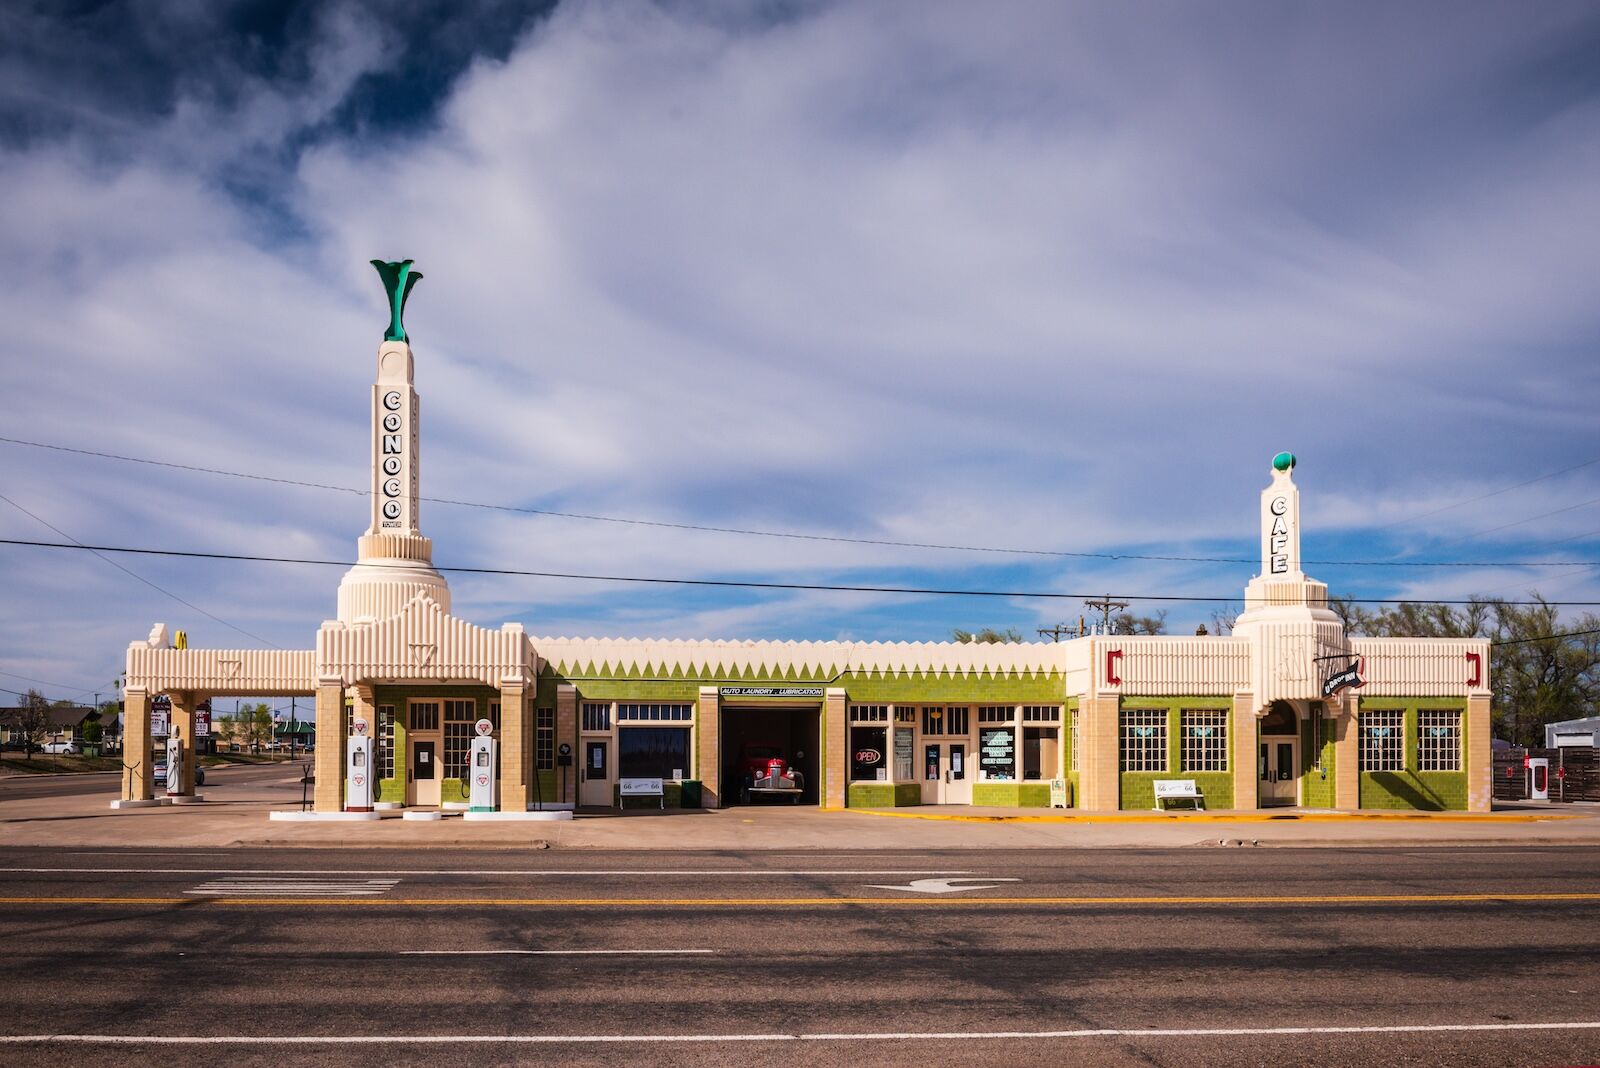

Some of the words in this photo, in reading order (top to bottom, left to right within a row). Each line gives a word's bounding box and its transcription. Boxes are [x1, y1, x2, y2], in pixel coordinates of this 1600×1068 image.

[383, 391, 402, 519] CONOCO
[1271, 496, 1288, 574] CAFE
[1325, 684, 1330, 694] U
[1329, 675, 1345, 688] DROP
[1345, 671, 1356, 682] INN
[856, 752, 877, 761] OPEN
